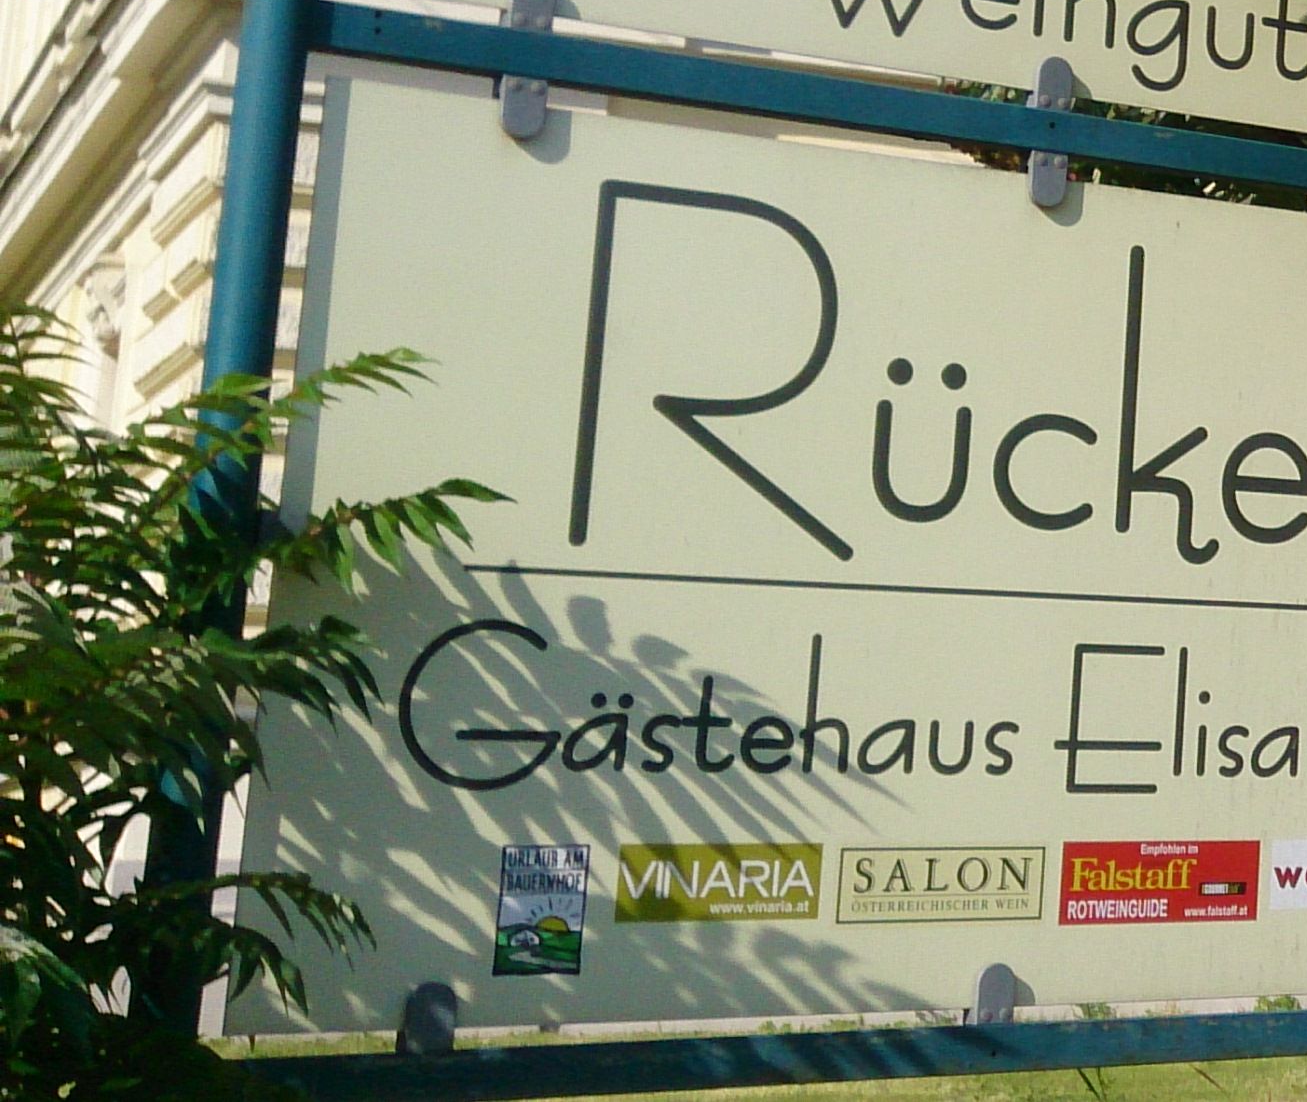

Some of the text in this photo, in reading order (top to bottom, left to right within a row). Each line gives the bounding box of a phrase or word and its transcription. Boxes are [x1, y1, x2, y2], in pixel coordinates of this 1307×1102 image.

[398, 618, 1019, 792] Gästehaus
[564, 848, 585, 868] AM
[1140, 843, 1199, 857] Empfohlen im
[506, 871, 583, 894] BAUERNHOF
[620, 859, 815, 900] VINARIA
[852, 856, 1035, 894] SALON
[1069, 856, 1198, 893] Falstaff
[708, 899, 810, 915] www.vinaria.at
[850, 896, 1031, 914] ÖSTERREICHISCHER WEIN
[1066, 897, 1169, 921] ROTWEINGUIDE
[1183, 904, 1249, 918] www.falstaff.at
